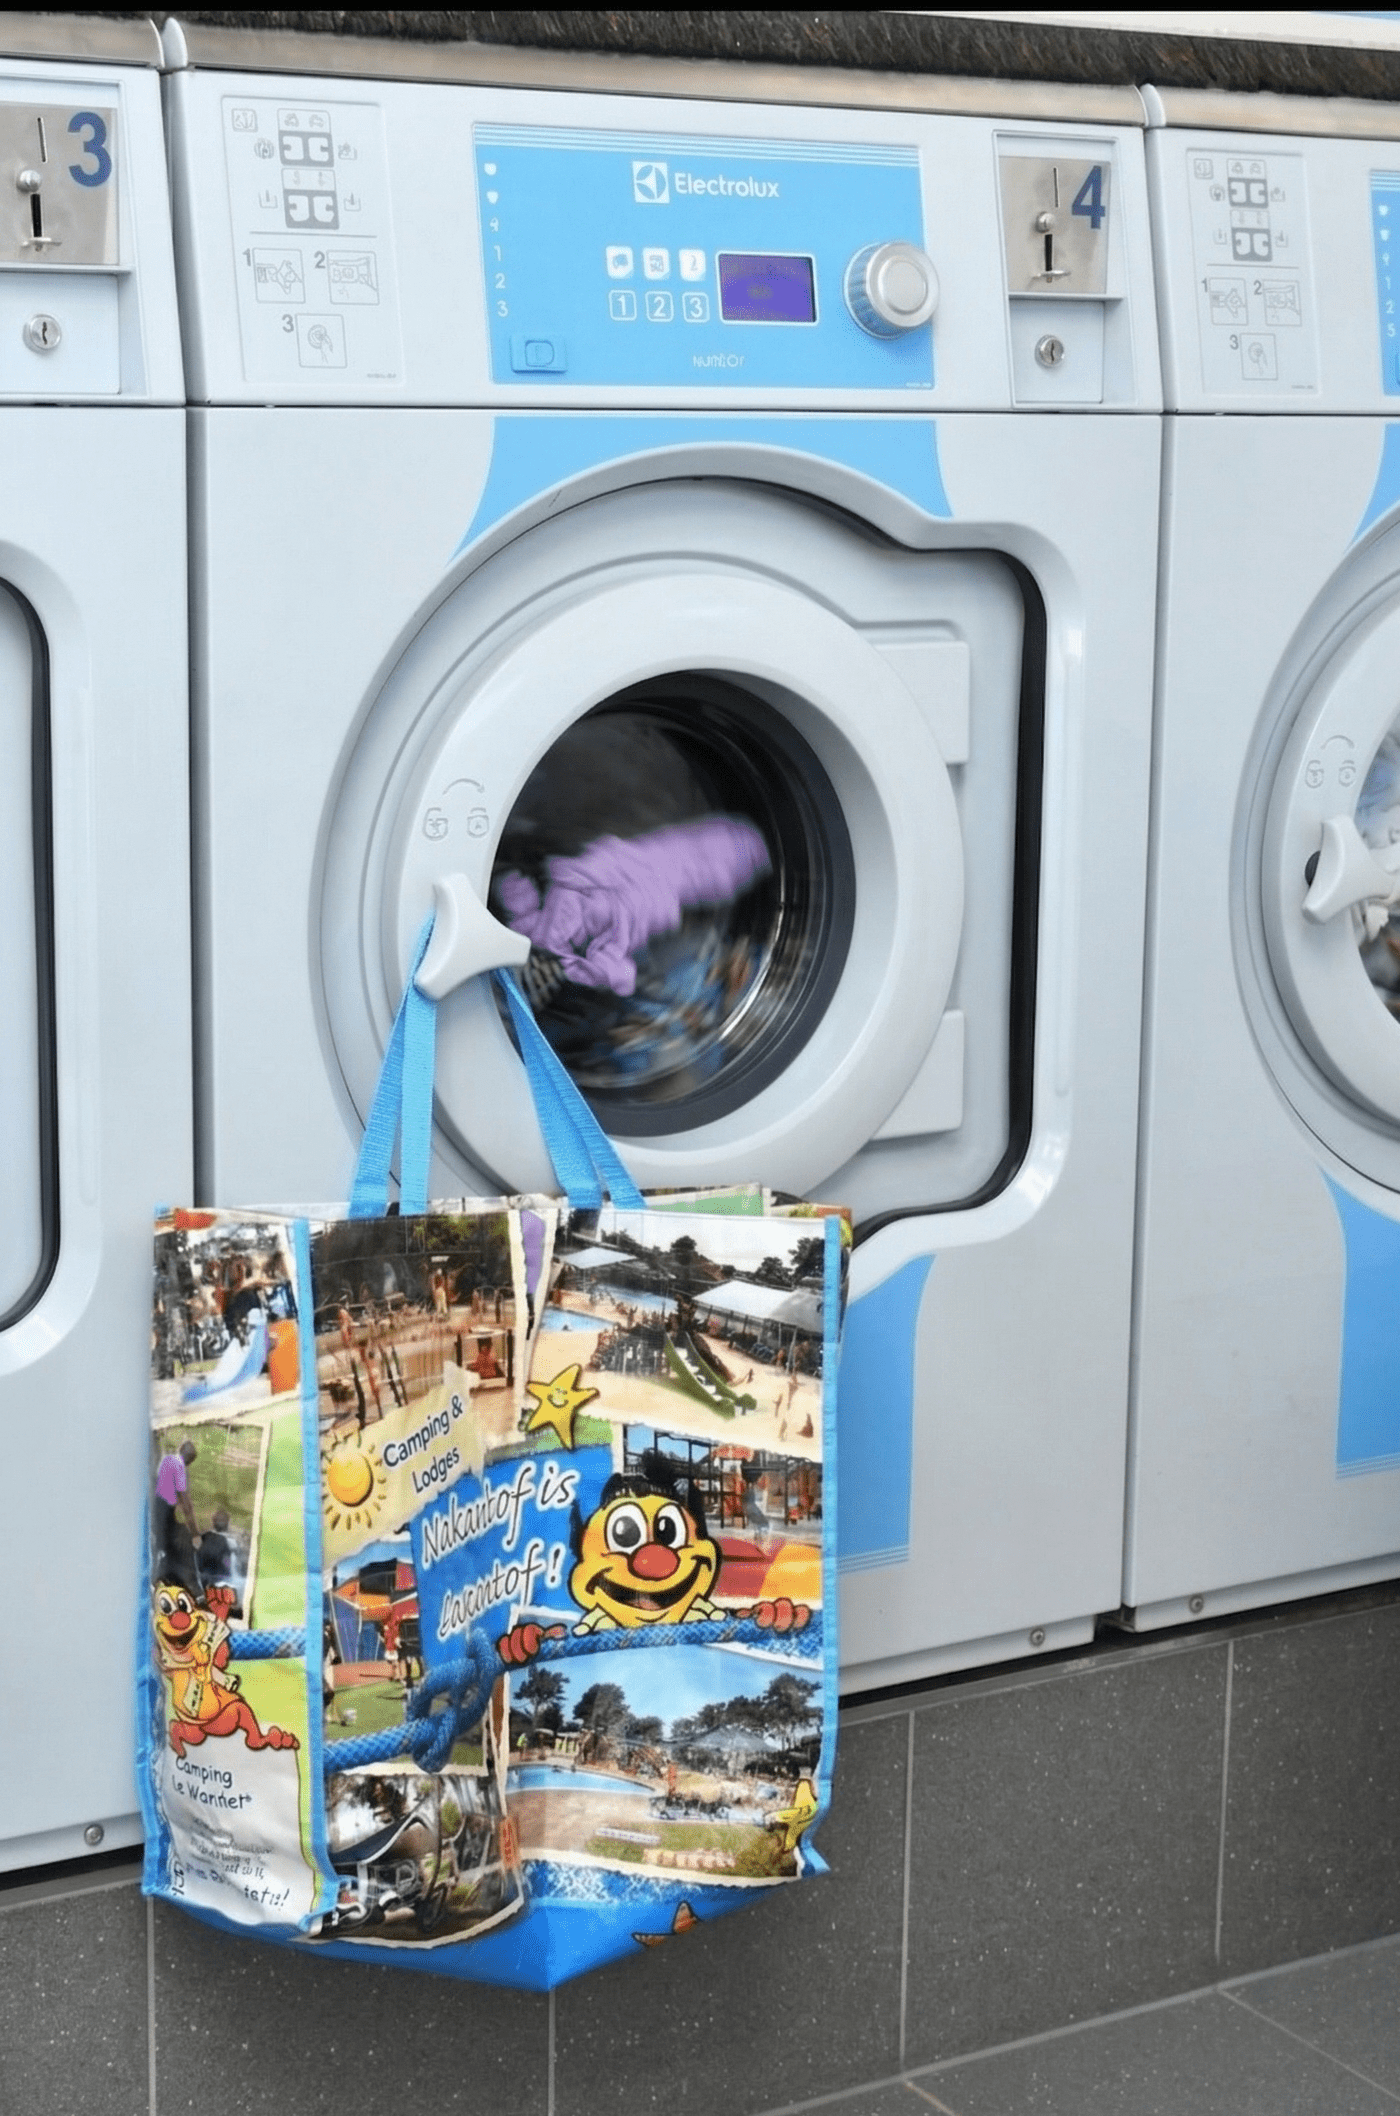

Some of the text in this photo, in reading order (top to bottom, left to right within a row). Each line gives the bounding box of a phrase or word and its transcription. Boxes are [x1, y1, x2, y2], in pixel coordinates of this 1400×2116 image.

[67, 111, 112, 188] 3
[674, 172, 780, 198] Electrolux
[1071, 165, 1106, 229] 4
[242, 248, 251, 266] 1
[313, 250, 326, 269] 2
[493, 245, 502, 261] 1
[495, 272, 506, 289] 2
[1201, 277, 1208, 293] 1
[1253, 279, 1263, 295] 2
[497, 300, 509, 317] 3
[617, 294, 703, 318] 1 2 3
[282, 313, 294, 333] 3
[1229, 334, 1239, 350] 3
[383, 1394, 463, 1468] Camping &
[411, 1447, 460, 1494] Lodges
[540, 1465, 576, 1506] is
[175, 1757, 233, 1789] Camping
